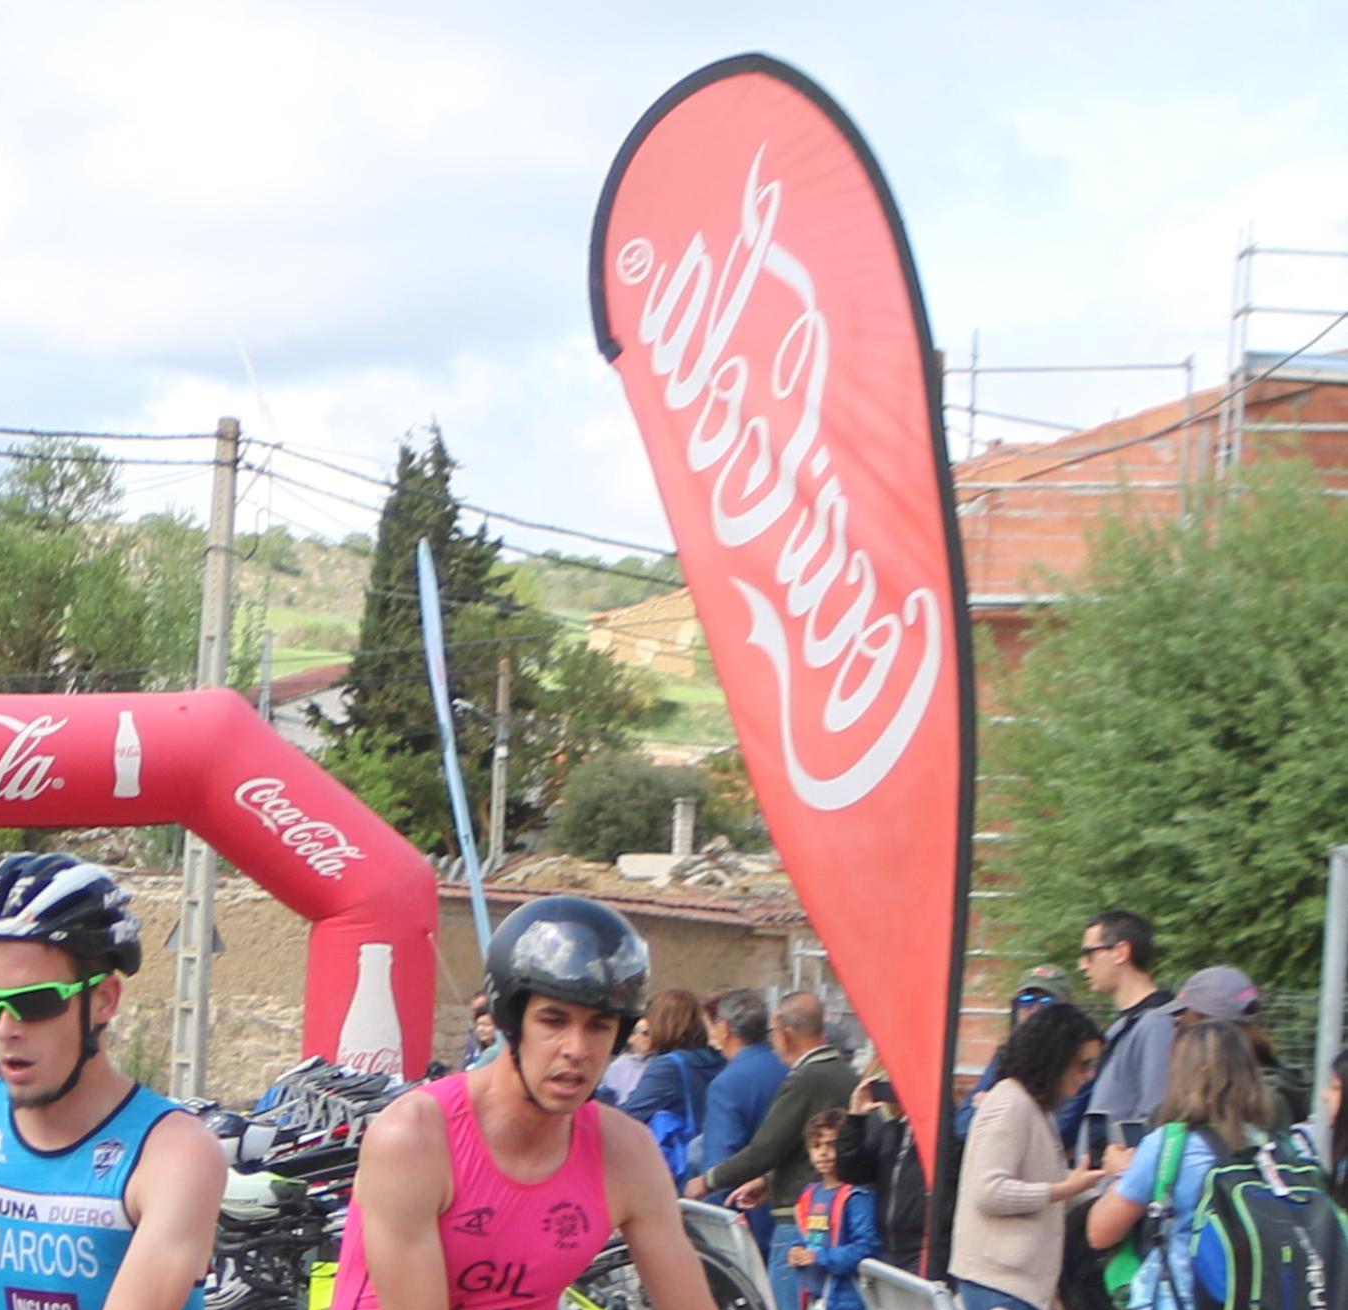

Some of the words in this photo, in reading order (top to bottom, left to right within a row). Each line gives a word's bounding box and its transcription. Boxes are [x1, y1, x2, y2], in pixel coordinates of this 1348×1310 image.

[234, 777, 366, 875] Coca-Cola
[48, 1205, 116, 1226] DUERO
[457, 1260, 537, 1298] GIL
